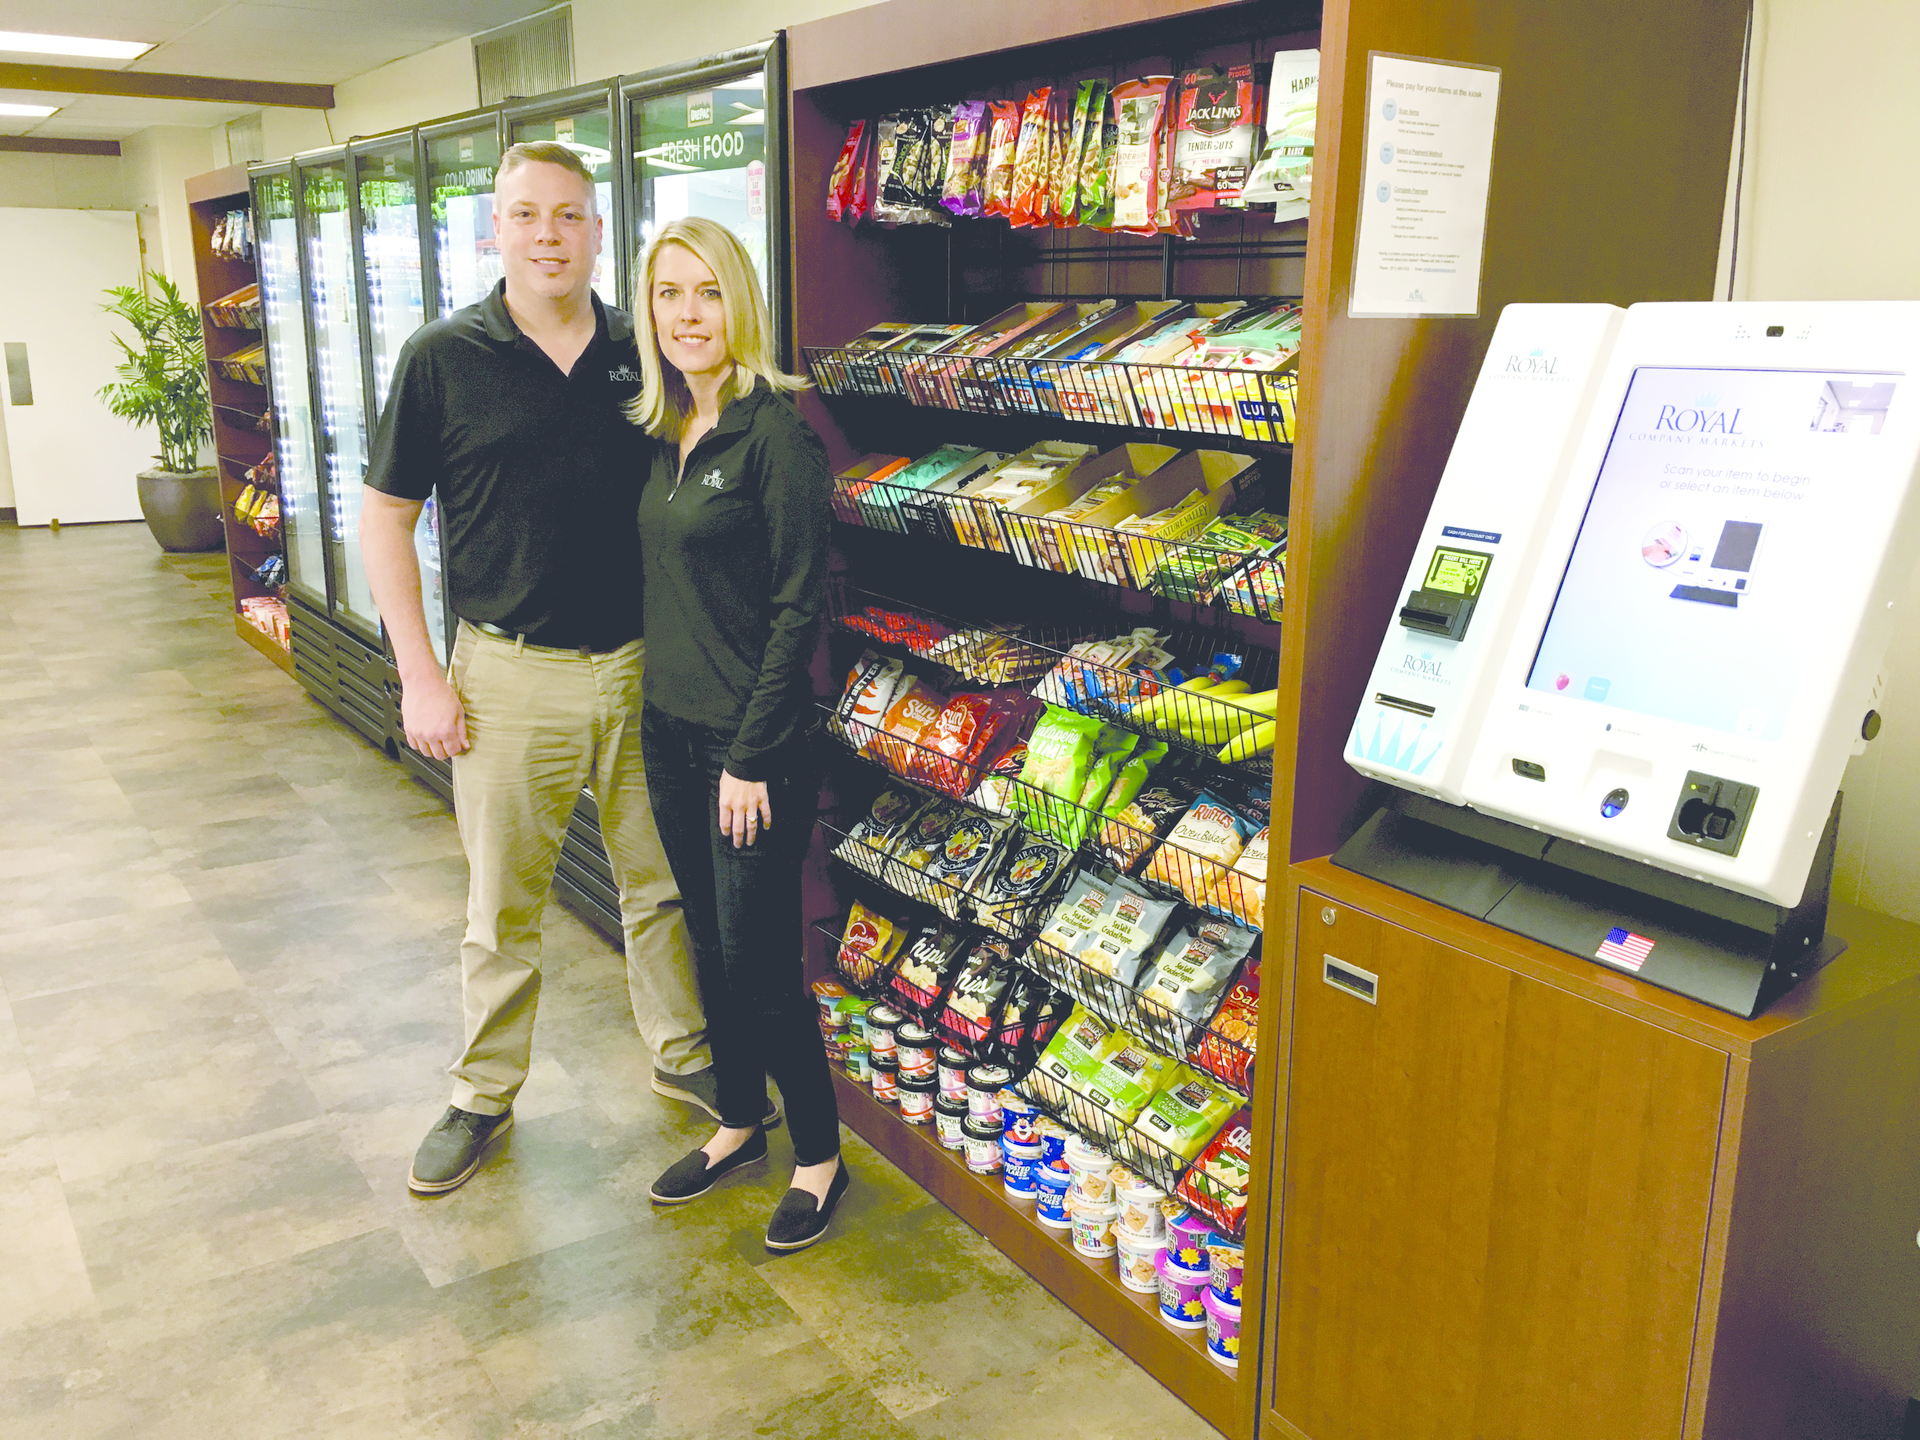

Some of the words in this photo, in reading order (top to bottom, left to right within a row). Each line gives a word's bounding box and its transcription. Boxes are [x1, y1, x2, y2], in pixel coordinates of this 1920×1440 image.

[1386, 79, 1404, 89] Please
[1406, 83, 1416, 92] pay
[1438, 86, 1451, 95] items
[1468, 90, 1482, 98] kiosk
[1186, 108, 1211, 122] JACK
[661, 138, 700, 164] FRESH
[703, 131, 744, 160] FOOD
[1188, 141, 1212, 152] TENDER
[1214, 140, 1234, 150] CUTS
[1396, 147, 1408, 155] Select
[1412, 148, 1428, 157] Payment
[445, 170, 465, 188] COLD
[466, 167, 492, 188] DRINKS
[1140, 170, 1152, 178] 350
[1394, 186, 1412, 194] Complete
[1412, 188, 1428, 196] Payment
[1505, 355, 1559, 375] ROYAL
[609, 370, 642, 382] ROYAL
[1655, 404, 1744, 435] ROYAL
[1628, 432, 1694, 444] COMPANY
[1698, 436, 1766, 449] MARKETS
[701, 474, 725, 490] ROYAL
[1663, 463, 1693, 475] Scan
[1696, 468, 1722, 479] your
[1725, 468, 1753, 480] item
[1757, 470, 1770, 482] to
[1772, 472, 1811, 487] begin
[1660, 480, 1672, 489] or
[1674, 481, 1710, 492] select
[1712, 485, 1730, 494] an
[1732, 486, 1760, 497] item
[1763, 487, 1804, 501] below
[1155, 518, 1184, 540] NATURE
[1183, 502, 1209, 526] VALLEY
[1402, 654, 1443, 677] ROYAL
[851, 662, 881, 697] BETTER
[1390, 666, 1420, 678] COMPANY
[1422, 674, 1452, 686] MARKETS
[1028, 738, 1068, 760] LIME
[1192, 804, 1235, 830] RUFFLES
[1174, 824, 1200, 837] Oven
[1200, 830, 1230, 845] Baked
[1122, 894, 1144, 912] BOULDER
[1072, 910, 1081, 921] Sea
[1102, 926, 1120, 940] Cracked
[1118, 933, 1132, 946] Pepper
[1112, 920, 1120, 929] Sea
[1120, 923, 1128, 934] Salt
[1204, 922, 1228, 940] BOULDER
[910, 937, 945, 964] hips
[1162, 964, 1180, 977] Cracked
[1178, 972, 1194, 984] Pepper
[1175, 962, 1184, 970] Sea
[1182, 965, 1190, 974] Salt
[1120, 1048, 1147, 1069] BOULDER
[1092, 1090, 1100, 1099] SEA
